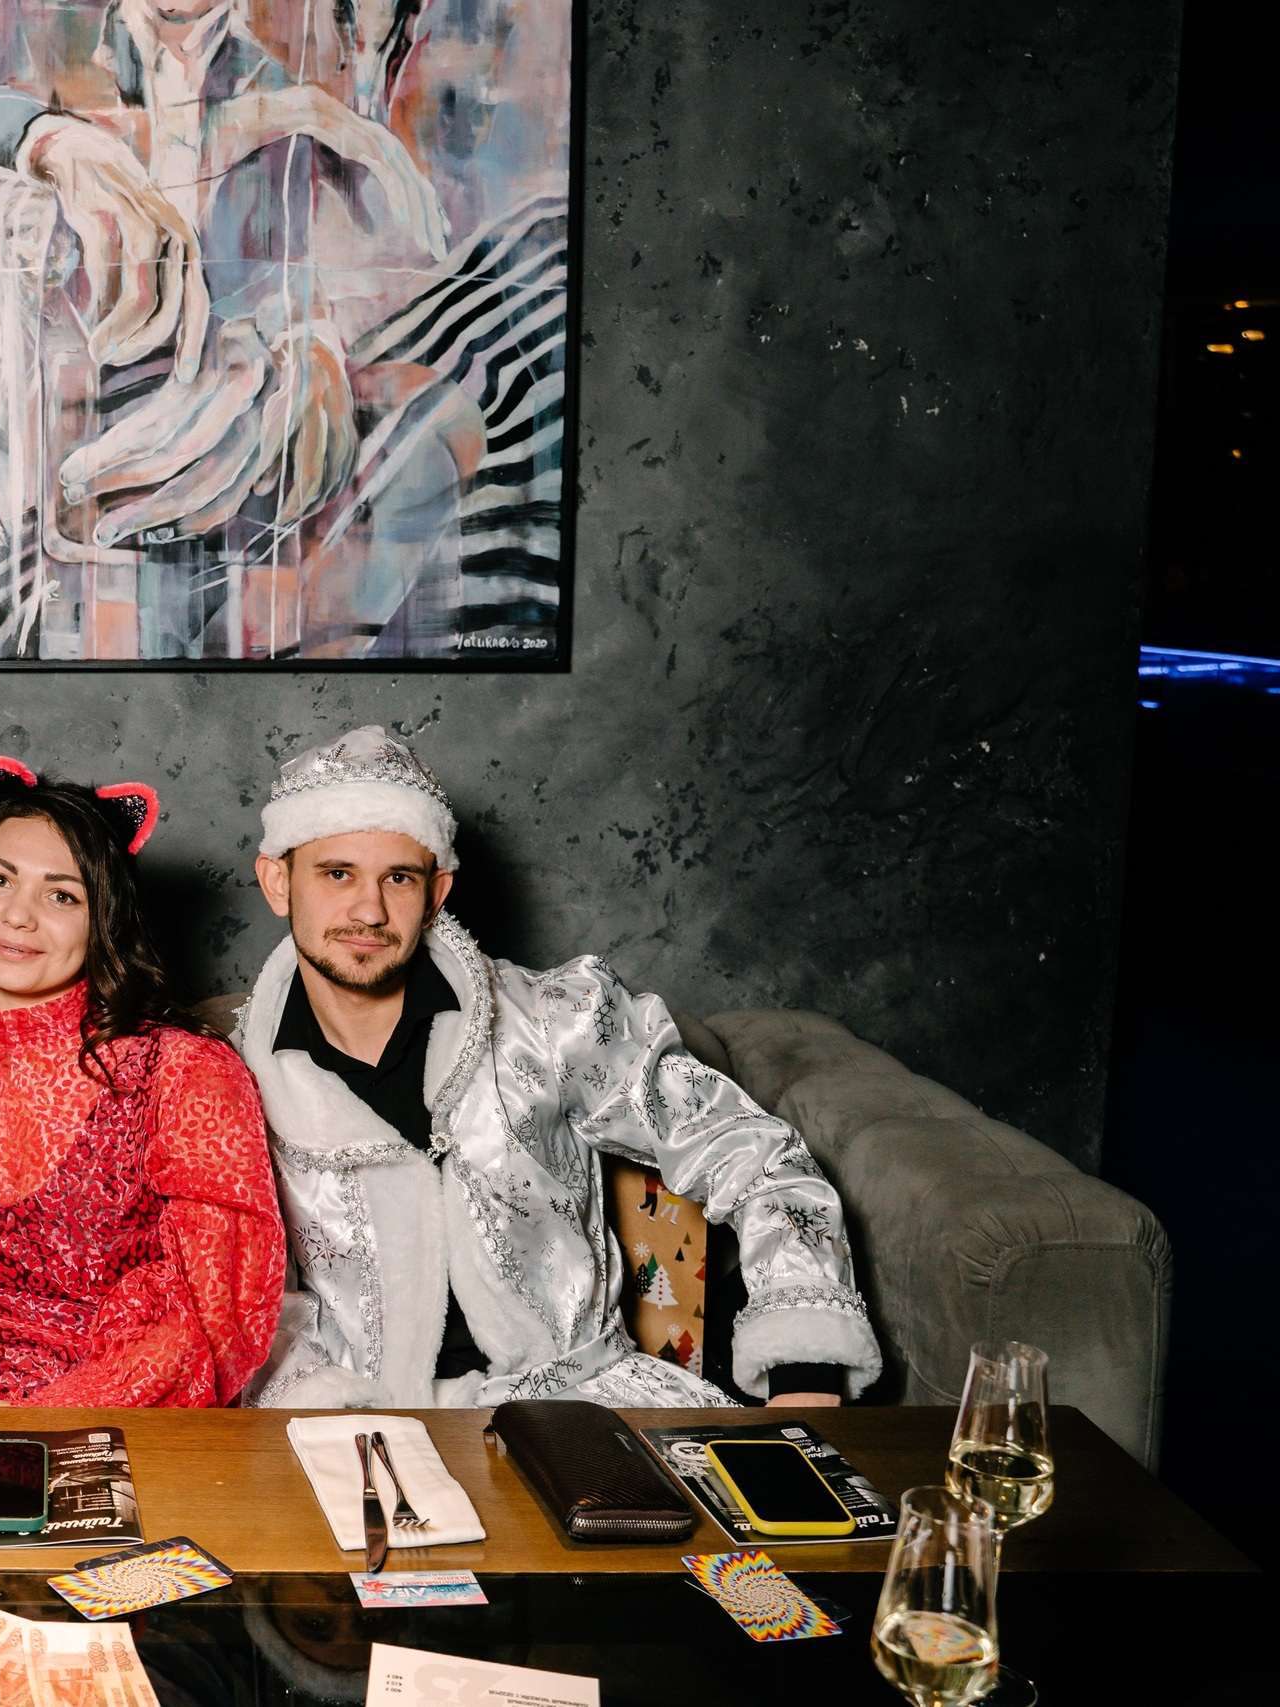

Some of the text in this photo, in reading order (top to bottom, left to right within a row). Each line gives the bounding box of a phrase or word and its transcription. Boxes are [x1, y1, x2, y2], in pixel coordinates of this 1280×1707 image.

[522, 637, 548, 649] 2020
[40, 1516, 124, 1534] Тайный
[854, 1513, 895, 1528] Тай
[87, 1641, 110, 1673] 5000
[111, 1641, 134, 1673] 5000
